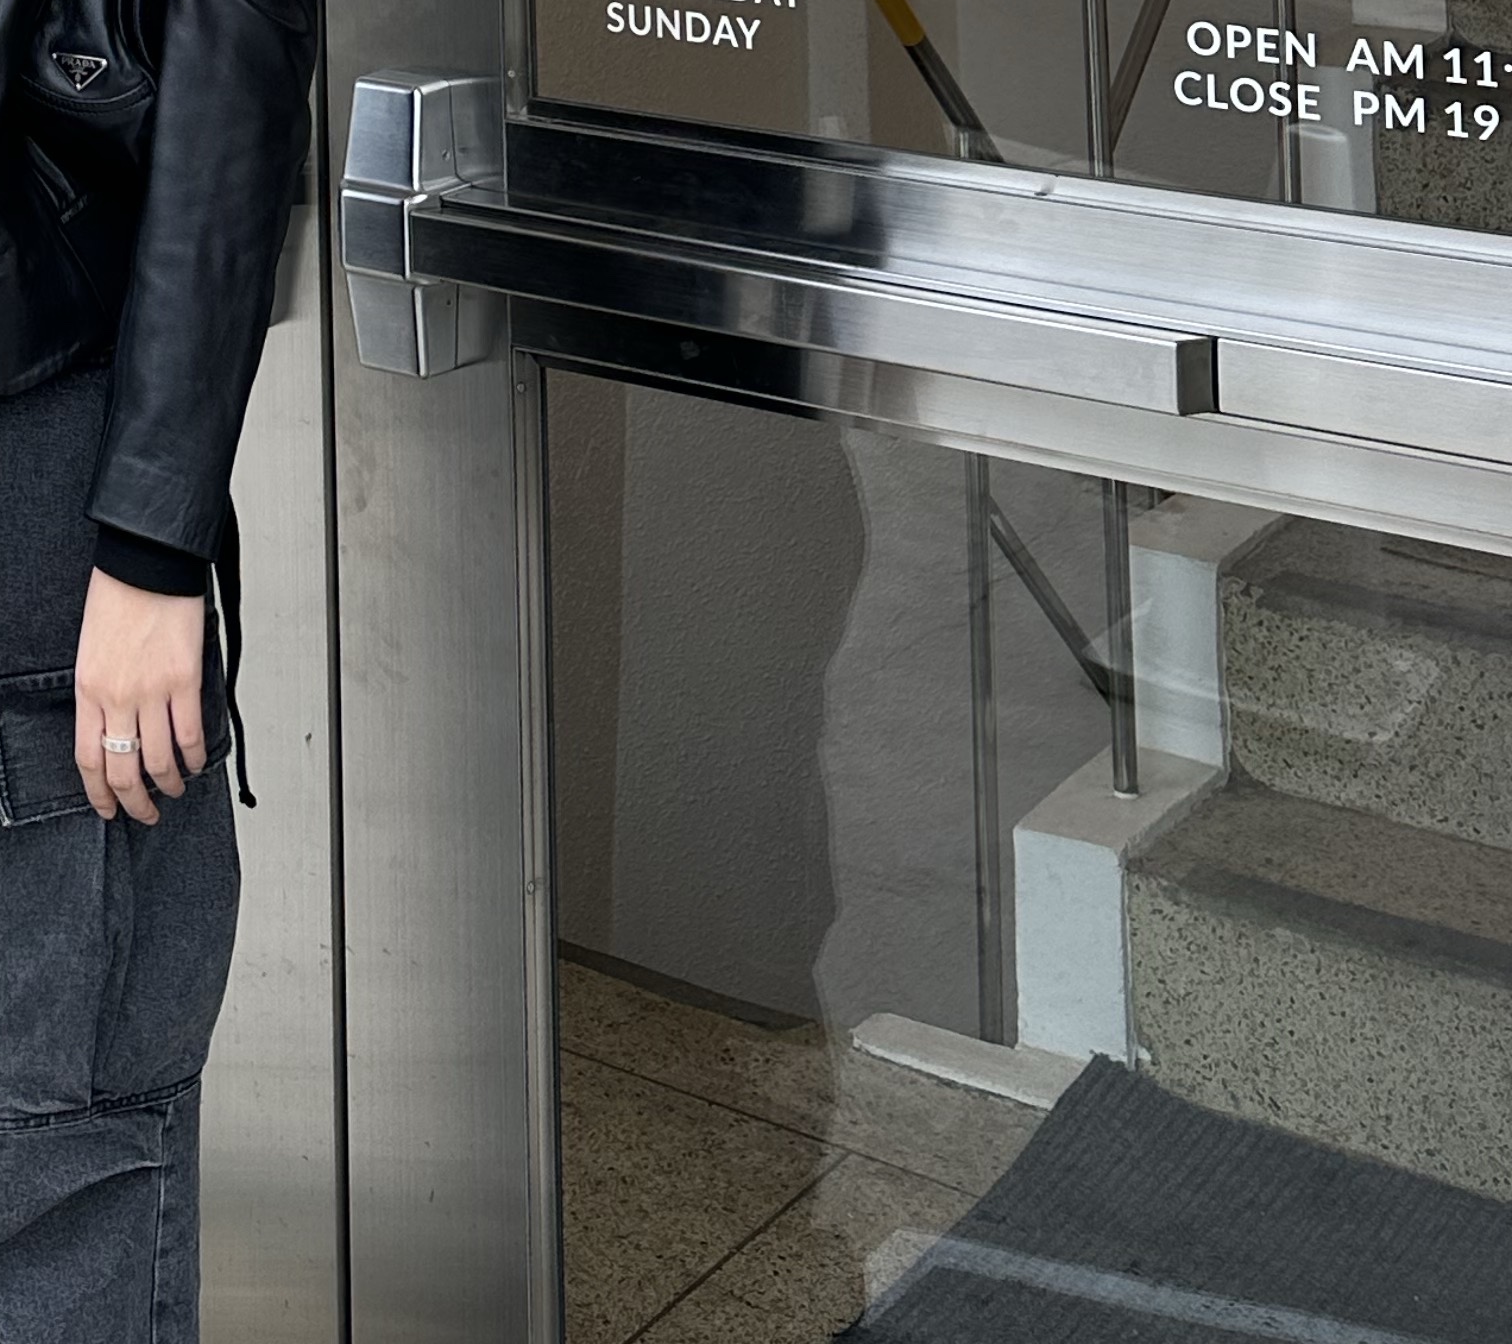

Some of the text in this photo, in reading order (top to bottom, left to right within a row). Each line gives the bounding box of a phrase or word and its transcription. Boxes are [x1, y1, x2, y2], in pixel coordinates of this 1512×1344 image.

[607, 1, 761, 50] SUNDAY
[1187, 21, 1316, 68] OPEN
[1346, 38, 1424, 79] AM
[61, 56, 96, 69] PRADA
[1174, 71, 1499, 141] CLOSE PM 19
